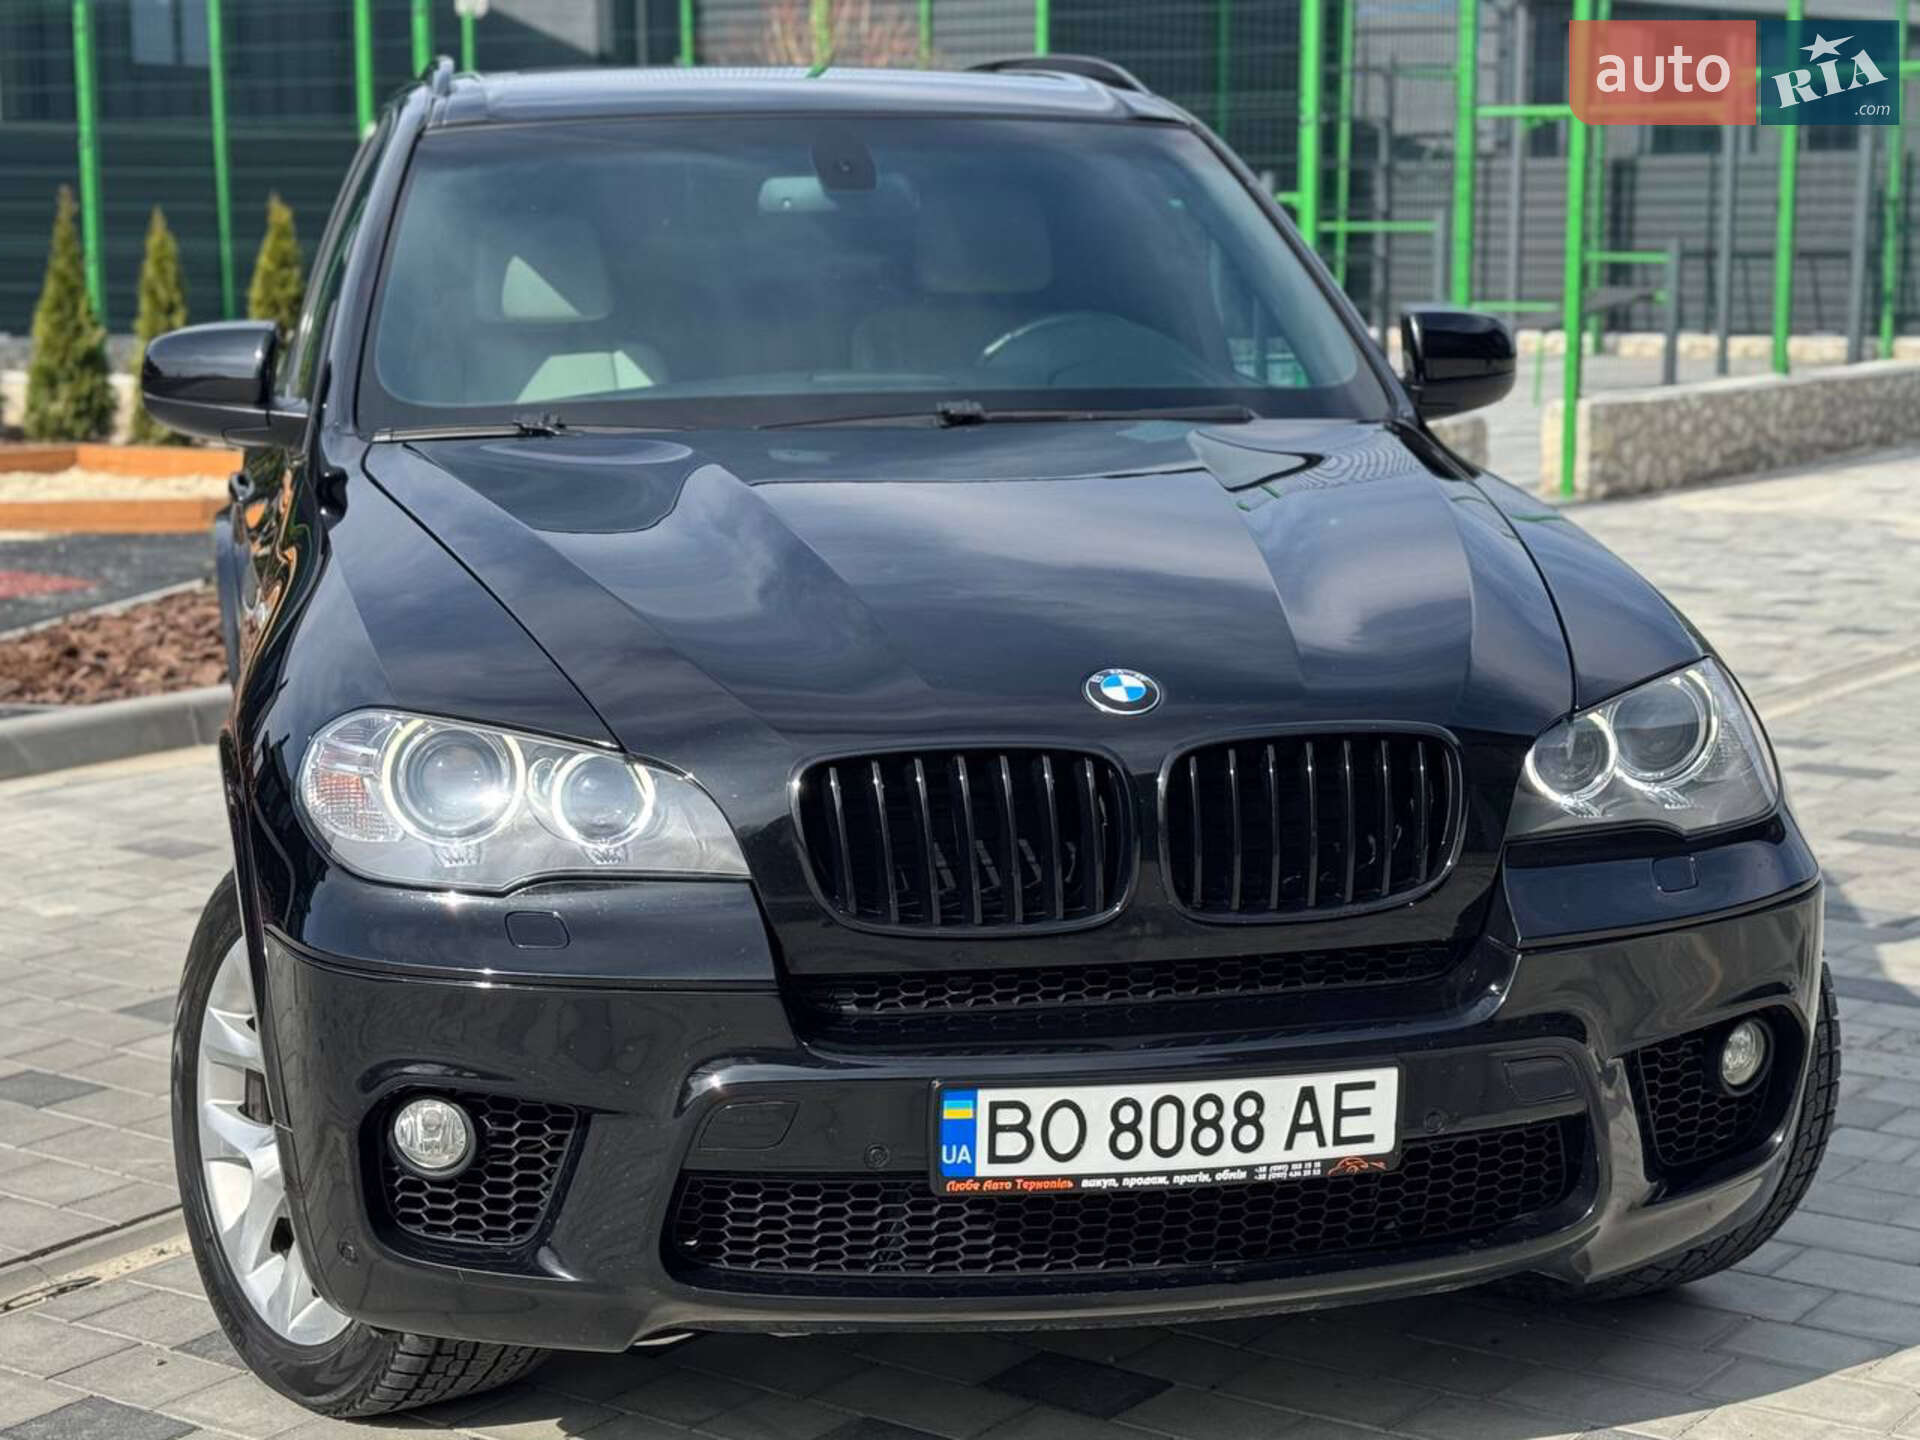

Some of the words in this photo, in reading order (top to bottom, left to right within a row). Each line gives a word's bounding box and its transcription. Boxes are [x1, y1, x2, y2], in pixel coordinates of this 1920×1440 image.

[987, 1099, 1088, 1165] BO
[1108, 1090, 1265, 1161] 8088
[1284, 1081, 1377, 1152] AE
[942, 1145, 972, 1165] UA
